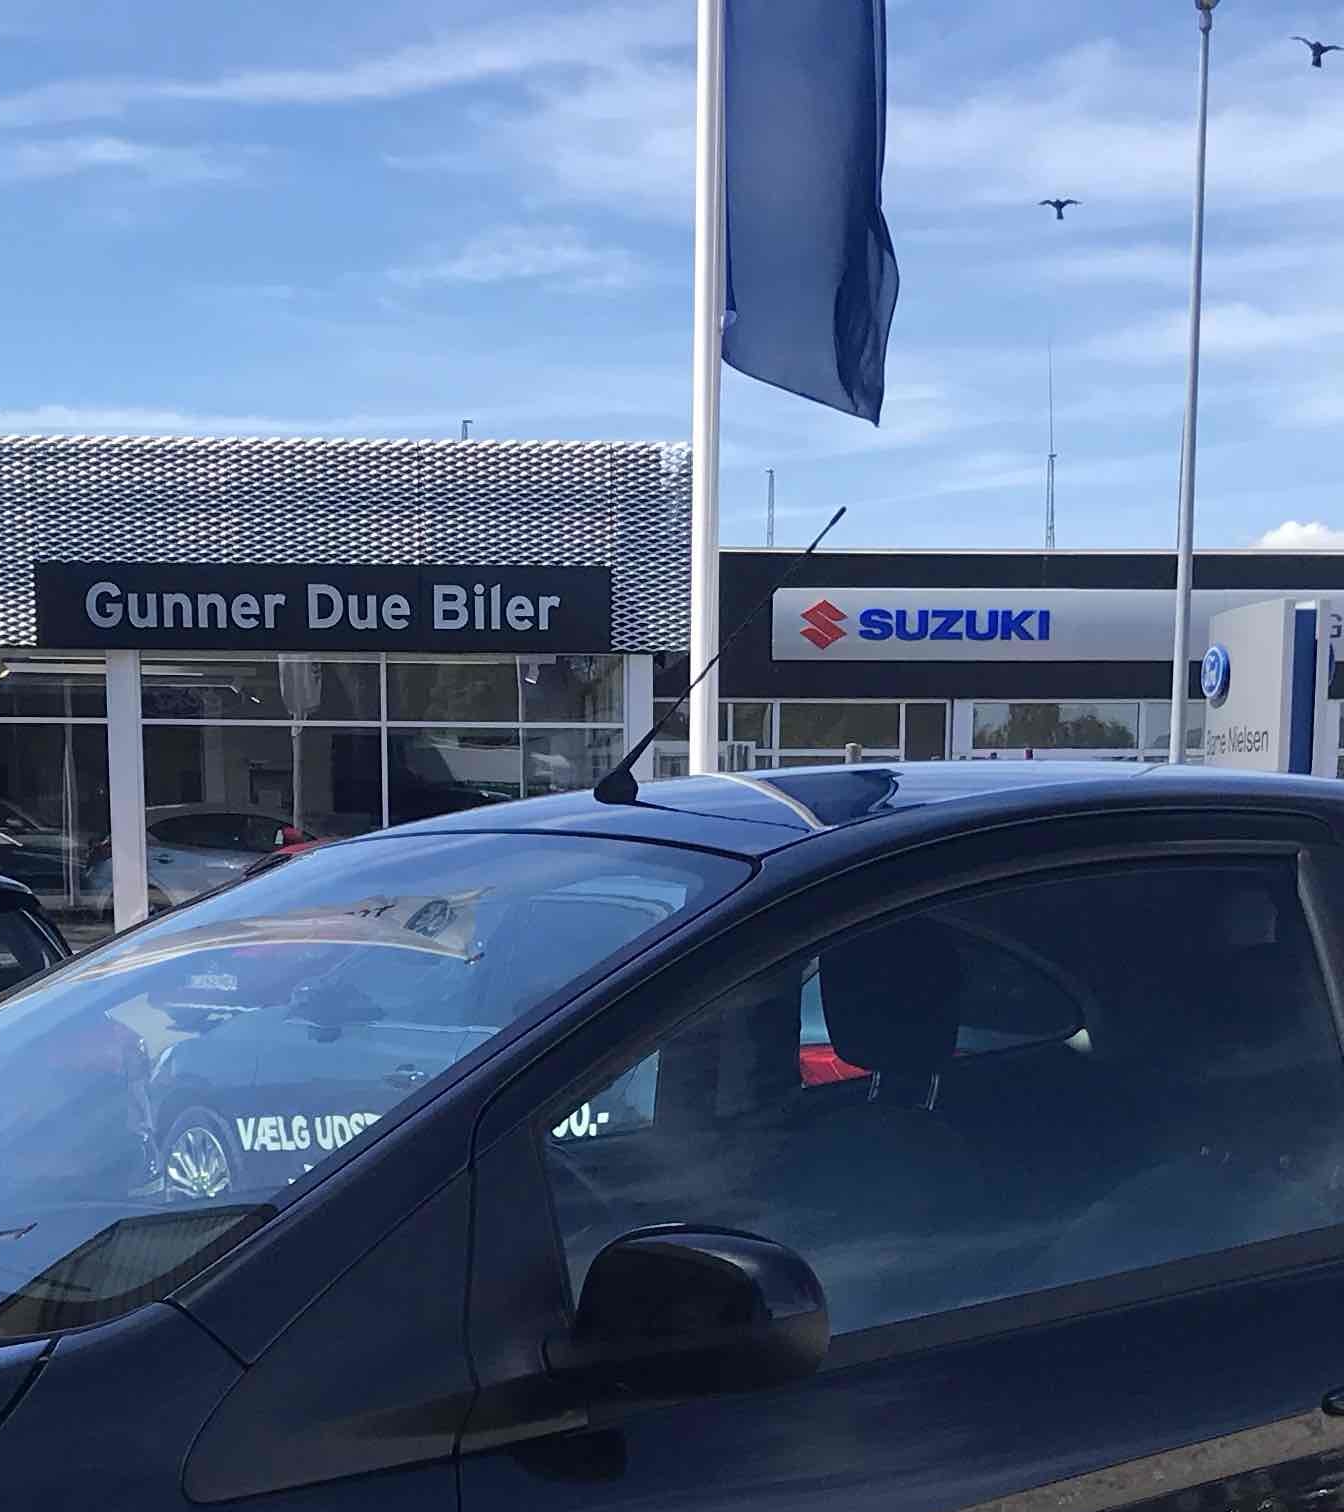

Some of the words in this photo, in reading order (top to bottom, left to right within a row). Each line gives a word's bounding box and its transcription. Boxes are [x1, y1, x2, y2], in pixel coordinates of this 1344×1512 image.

[85, 582, 286, 629] Gunner
[307, 583, 411, 629] Due
[433, 583, 561, 629] Biler
[858, 609, 1051, 641] SUZUKI
[236, 1114, 310, 1151] VÆLG
